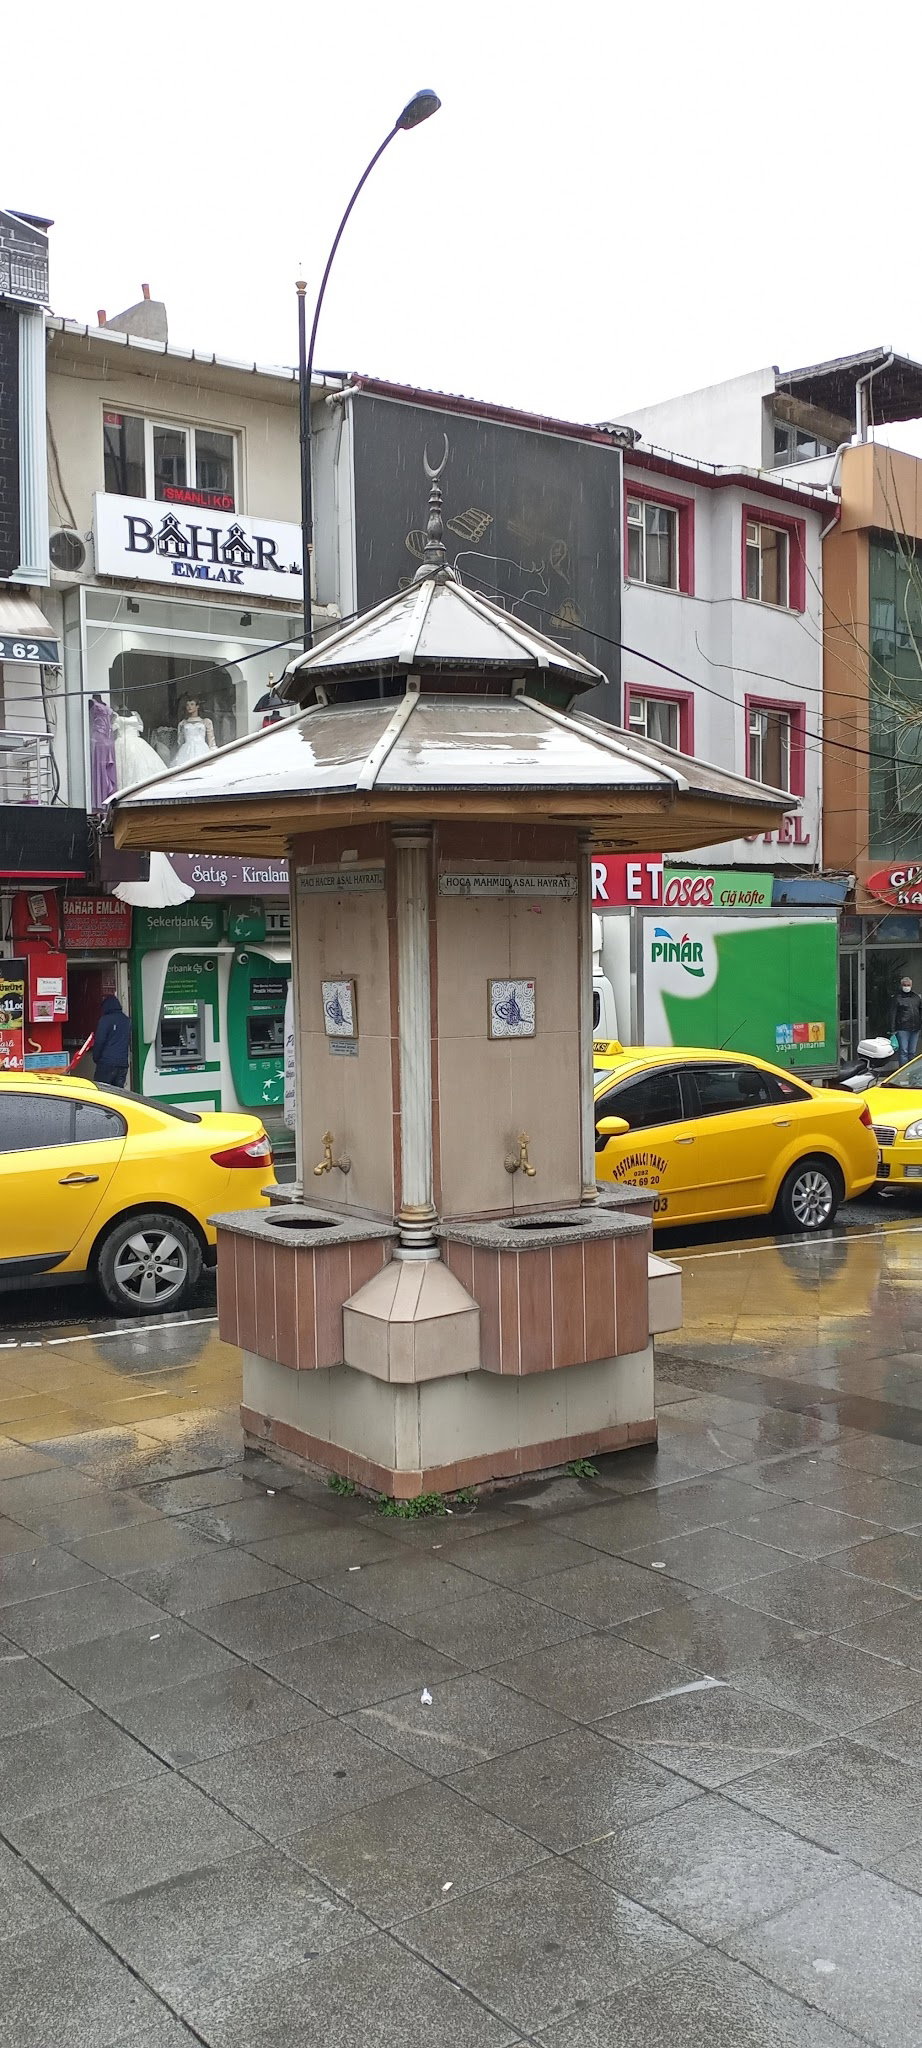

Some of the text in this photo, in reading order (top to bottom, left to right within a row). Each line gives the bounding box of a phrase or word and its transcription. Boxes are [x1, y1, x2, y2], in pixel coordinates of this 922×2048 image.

[171, 561, 245, 586] EMLAK
[12, 643, 40, 659] 62
[191, 865, 228, 887] Satış
[315, 877, 335, 887] HACER
[446, 877, 472, 887] HOCA
[473, 878, 511, 887] MAHMUD
[513, 878, 535, 887] ASAL
[626, 862, 663, 900] ET
[720, 890, 738, 907] Çiğ
[738, 889, 766, 905] köfte
[63, 901, 94, 915] BAHAR
[96, 901, 127, 915] EMLAK
[146, 915, 200, 930] Şekerbank
[638, 1177, 649, 1186] 69
[650, 1175, 660, 1185] 20
